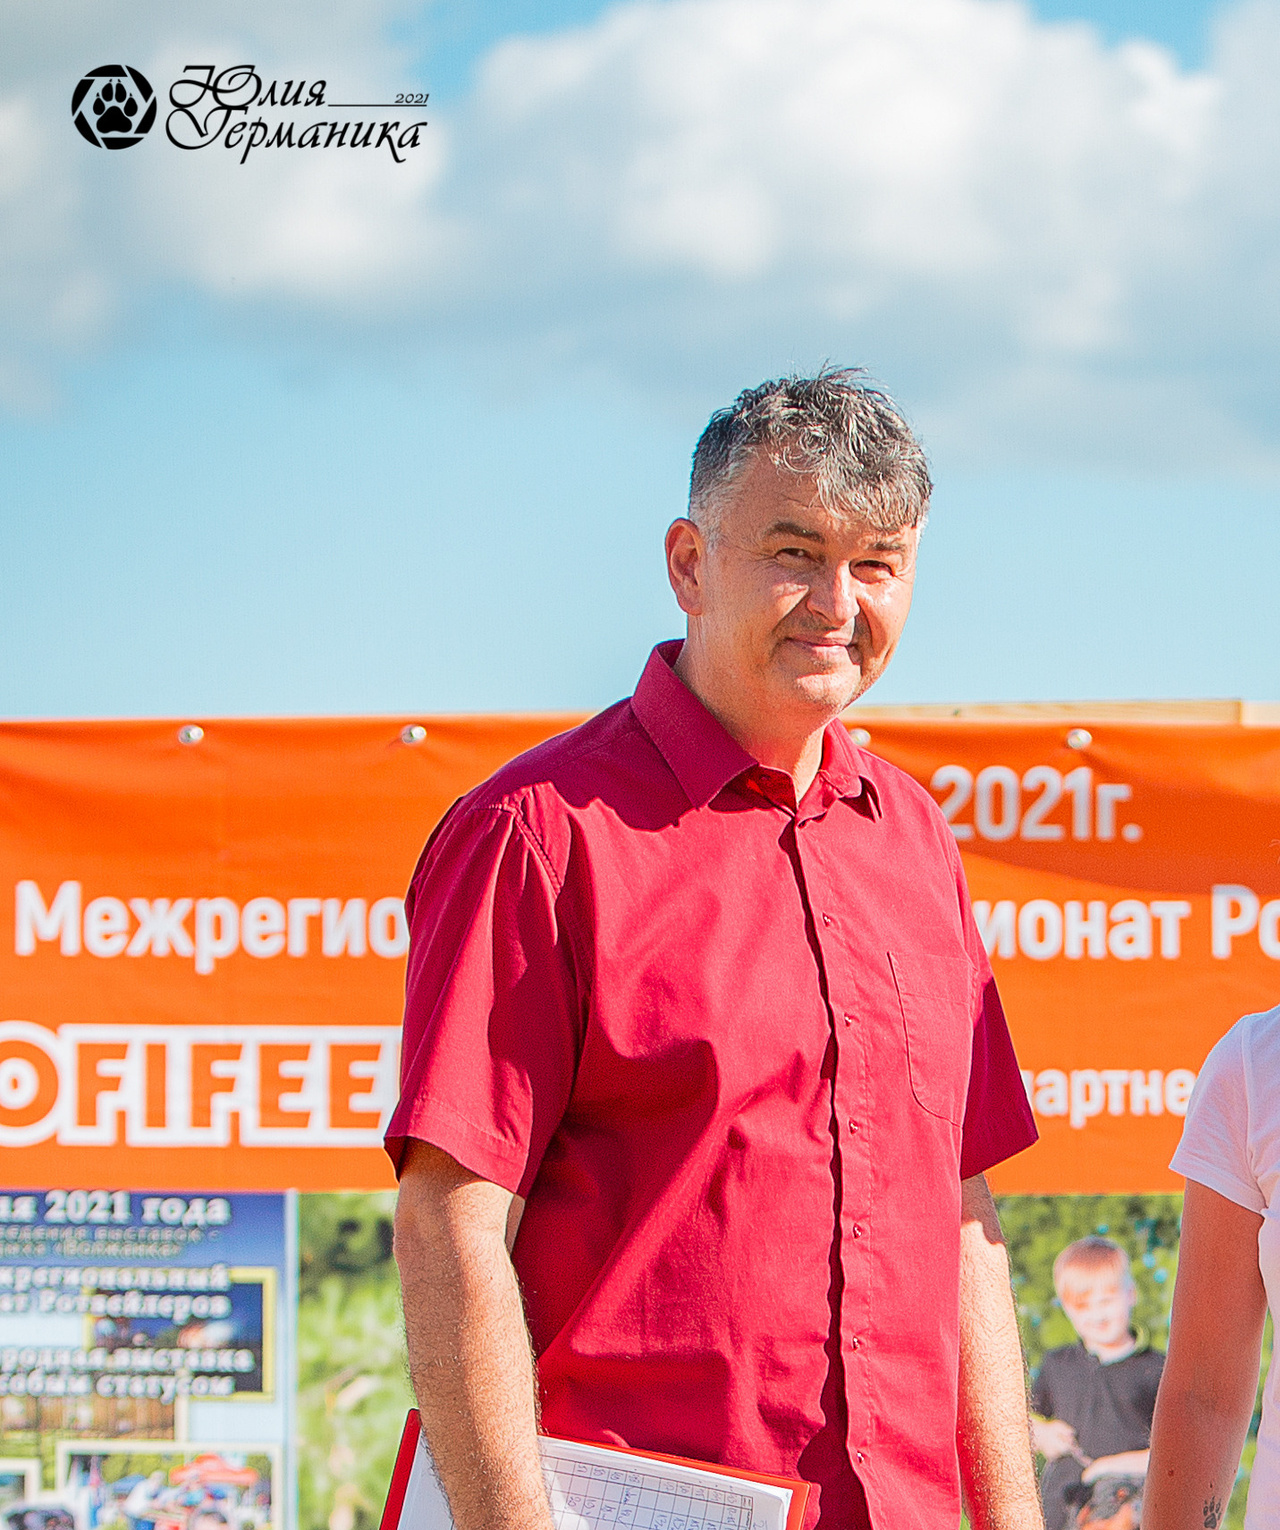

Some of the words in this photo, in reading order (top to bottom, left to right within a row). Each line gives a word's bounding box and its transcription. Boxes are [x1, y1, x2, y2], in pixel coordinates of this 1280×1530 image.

[930, 765, 1142, 841] 2021г.
[44, 1189, 132, 1225] 2021
[141, 1197, 233, 1229] года
[39, 1288, 233, 1326] Ротвейлеров
[96, 1375, 237, 1405] статусом
